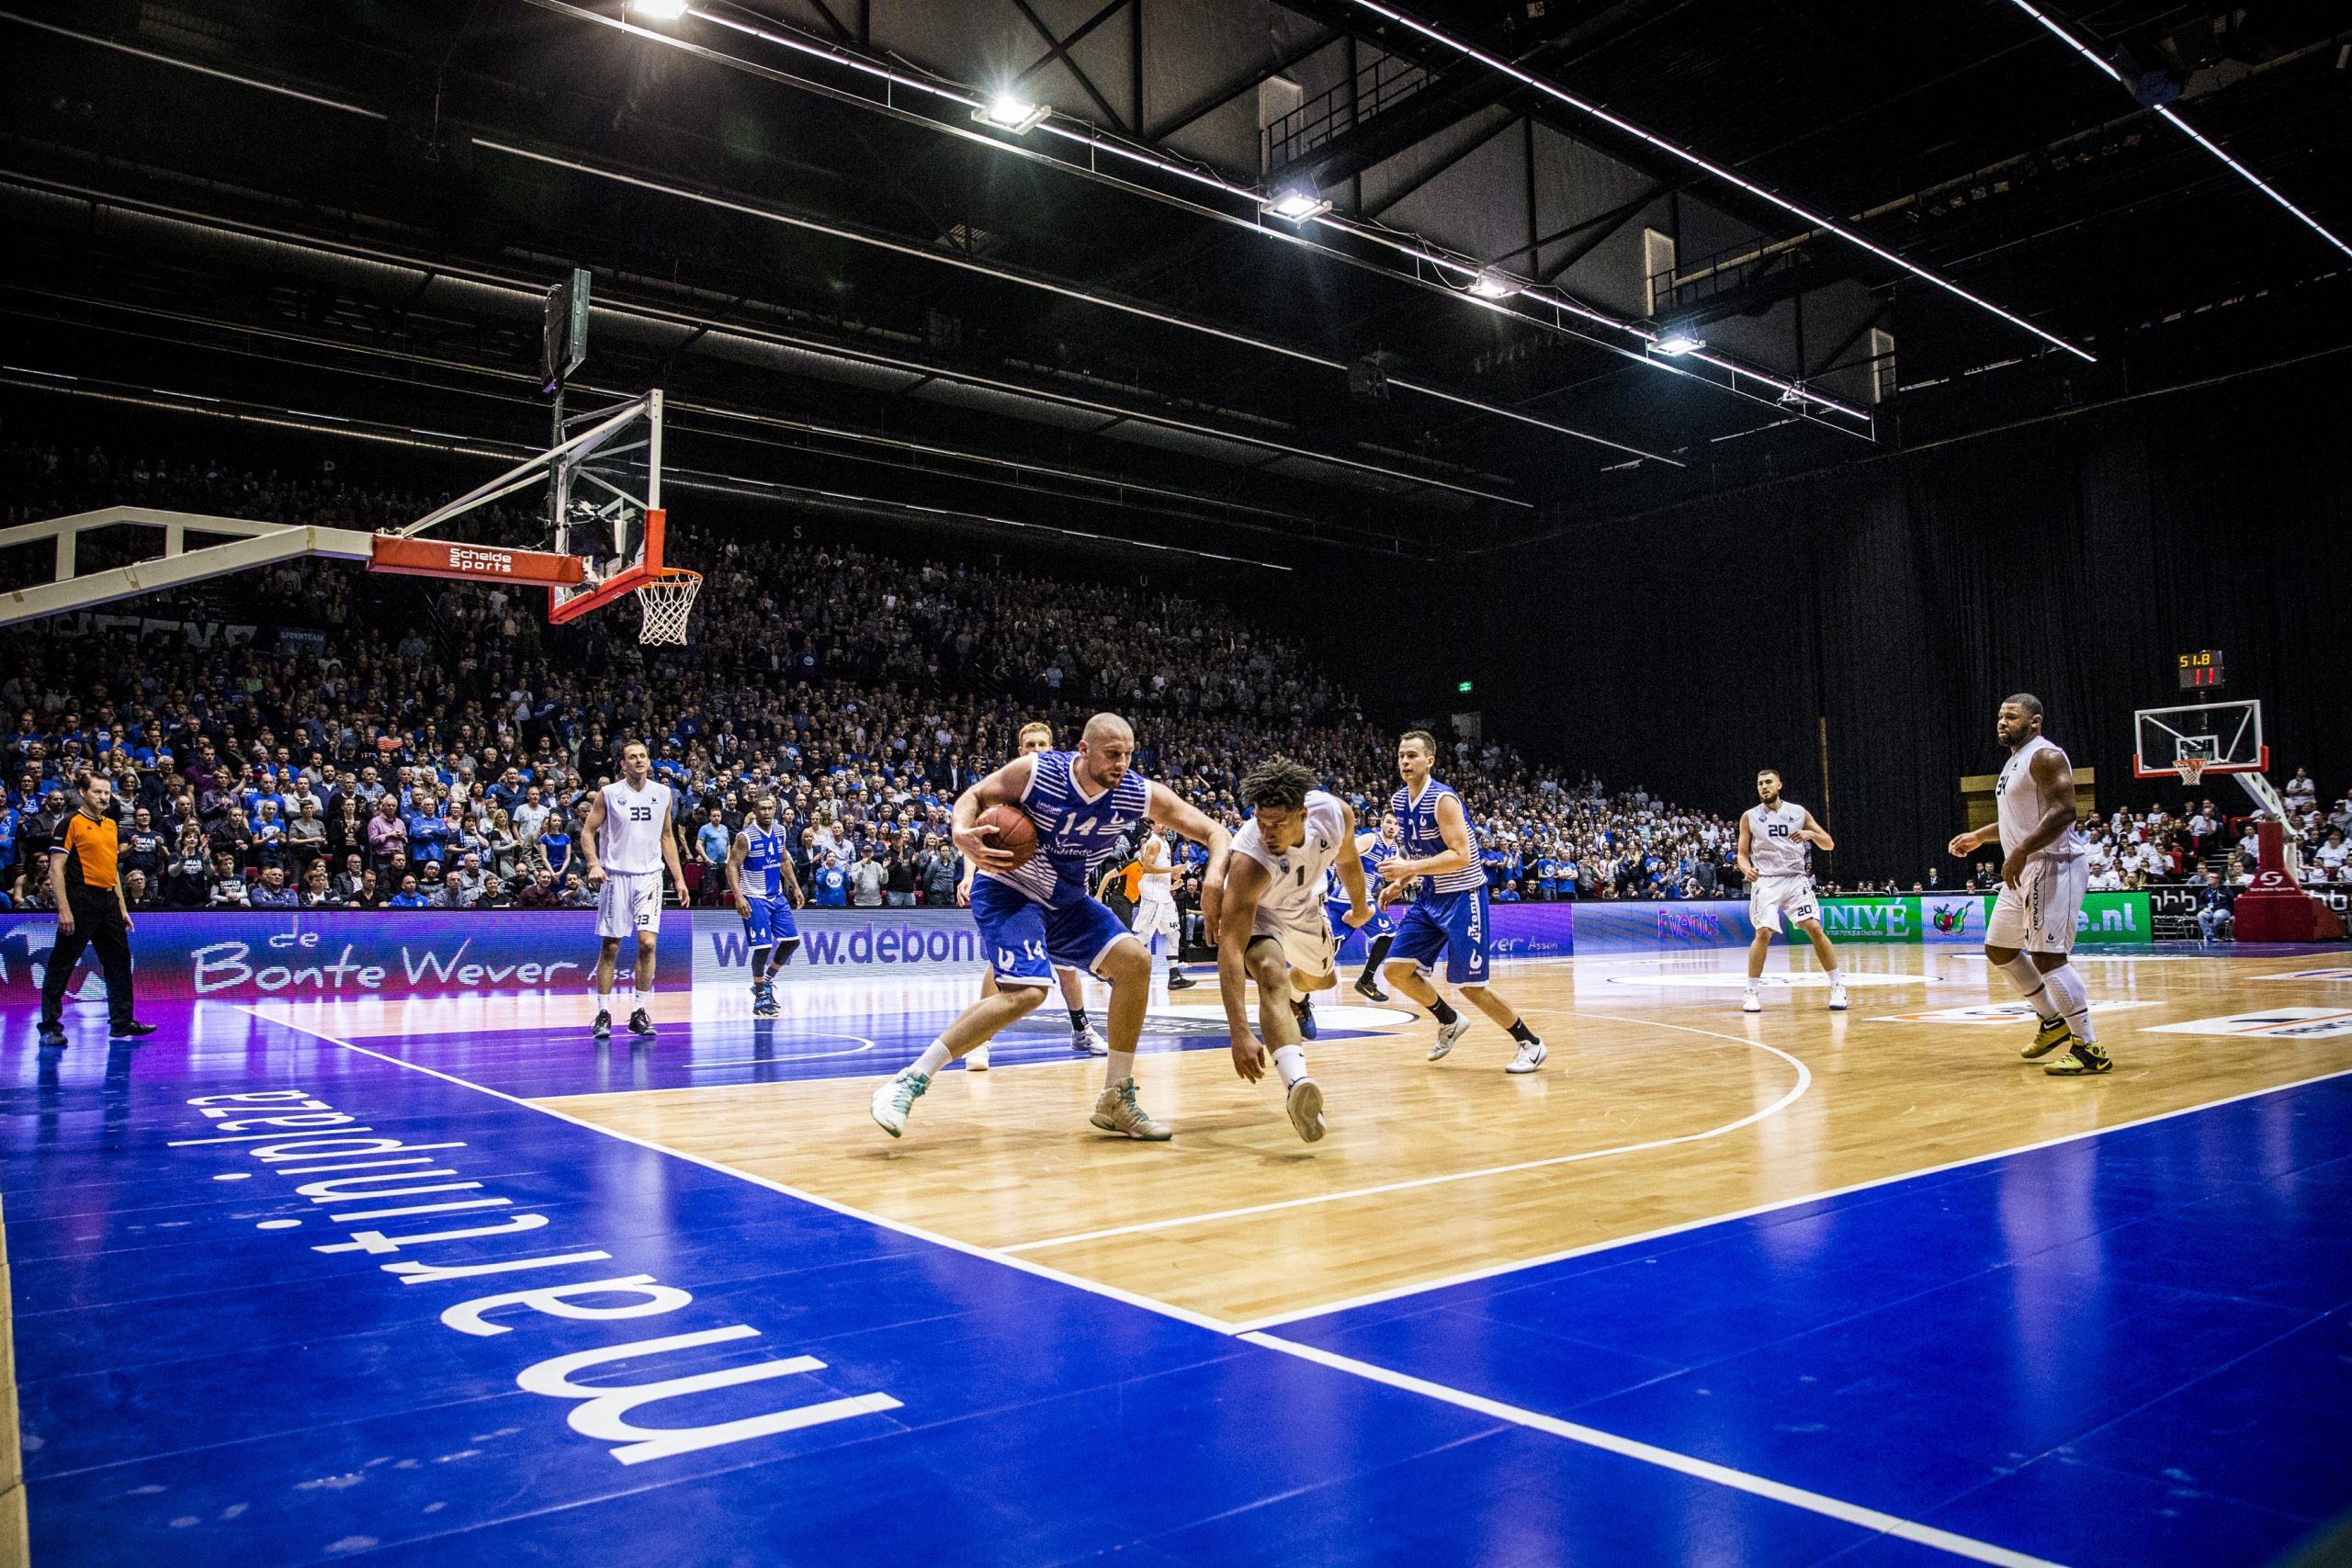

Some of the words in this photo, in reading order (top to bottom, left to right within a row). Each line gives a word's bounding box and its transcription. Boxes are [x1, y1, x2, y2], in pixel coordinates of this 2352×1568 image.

[449, 547, 512, 563] Schelde
[449, 558, 512, 572] Sports
[2179, 653, 2211, 668] 51.8
[2195, 668, 2215, 685] 11
[1996, 775, 2009, 796] 34
[629, 807, 651, 821] 33
[1058, 812, 1098, 836] 14
[1768, 824, 1789, 837] 20
[768, 841, 775, 855] 4
[1295, 864, 1306, 887] 1
[1797, 905, 1813, 917] 20
[2075, 902, 2137, 932] e.nl
[268, 917, 319, 948] de
[761, 927, 766, 938] 4
[1657, 908, 1720, 939] Events
[1023, 939, 1046, 961] 14
[191, 941, 386, 994] Bonte
[401, 937, 579, 987] Wever
[167, 1089, 905, 1466] martiniplaza
